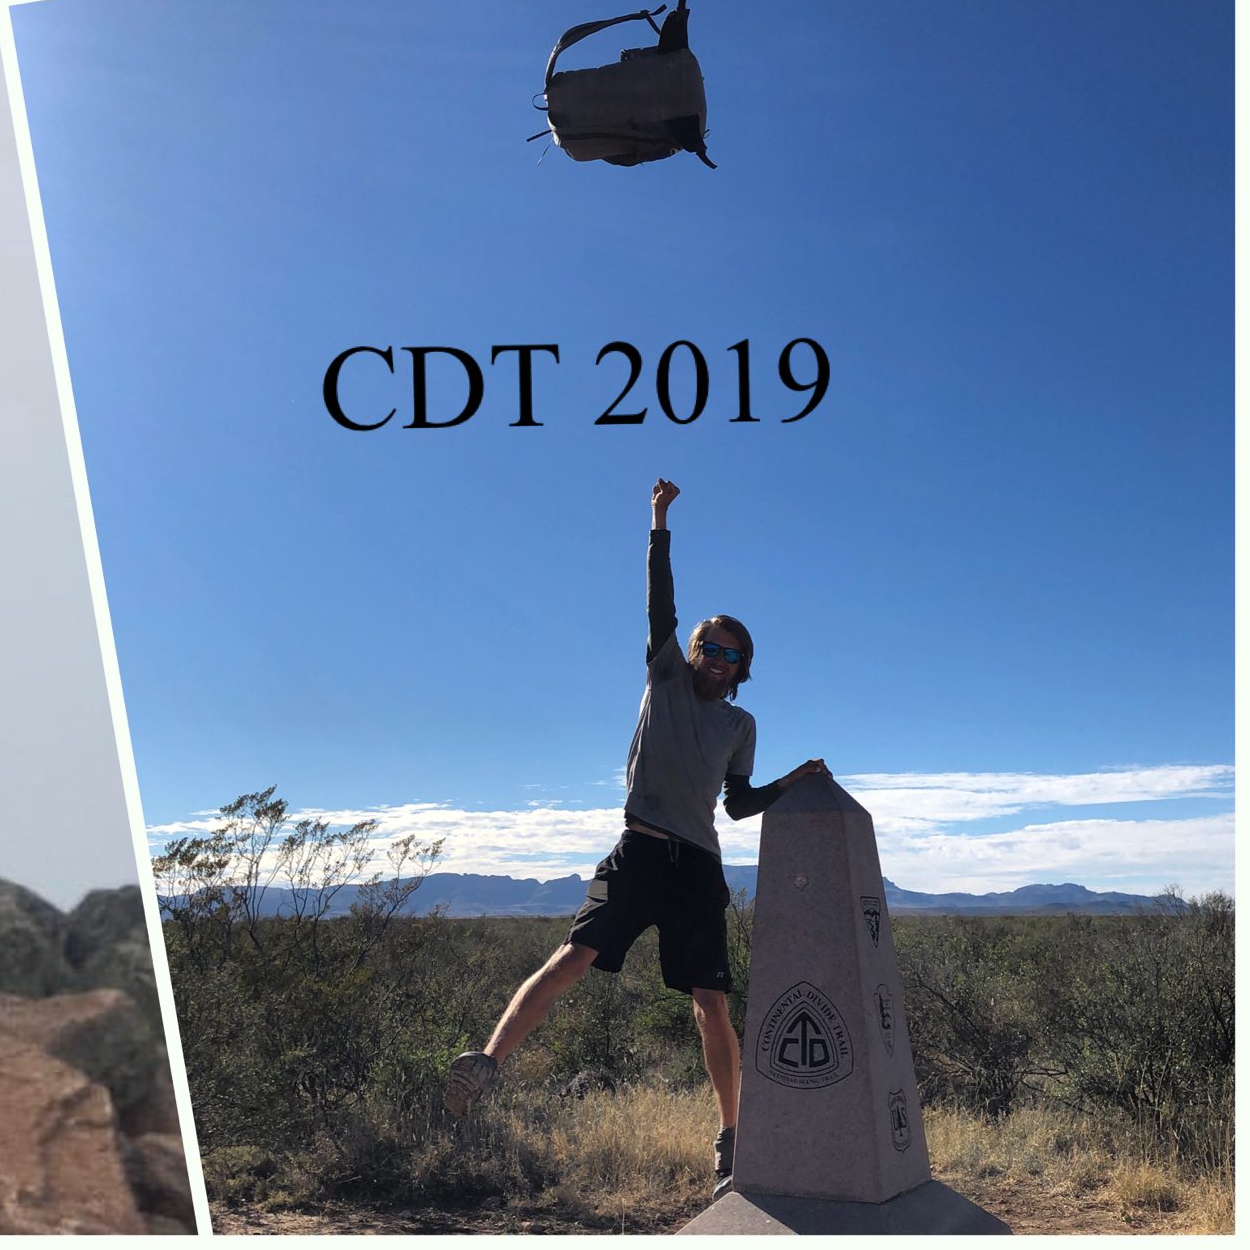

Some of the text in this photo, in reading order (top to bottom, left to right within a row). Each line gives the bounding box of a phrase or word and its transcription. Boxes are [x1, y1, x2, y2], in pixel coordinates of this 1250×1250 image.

[762, 989, 849, 1059] CONTINENTAL DIVIDE TRAIL
